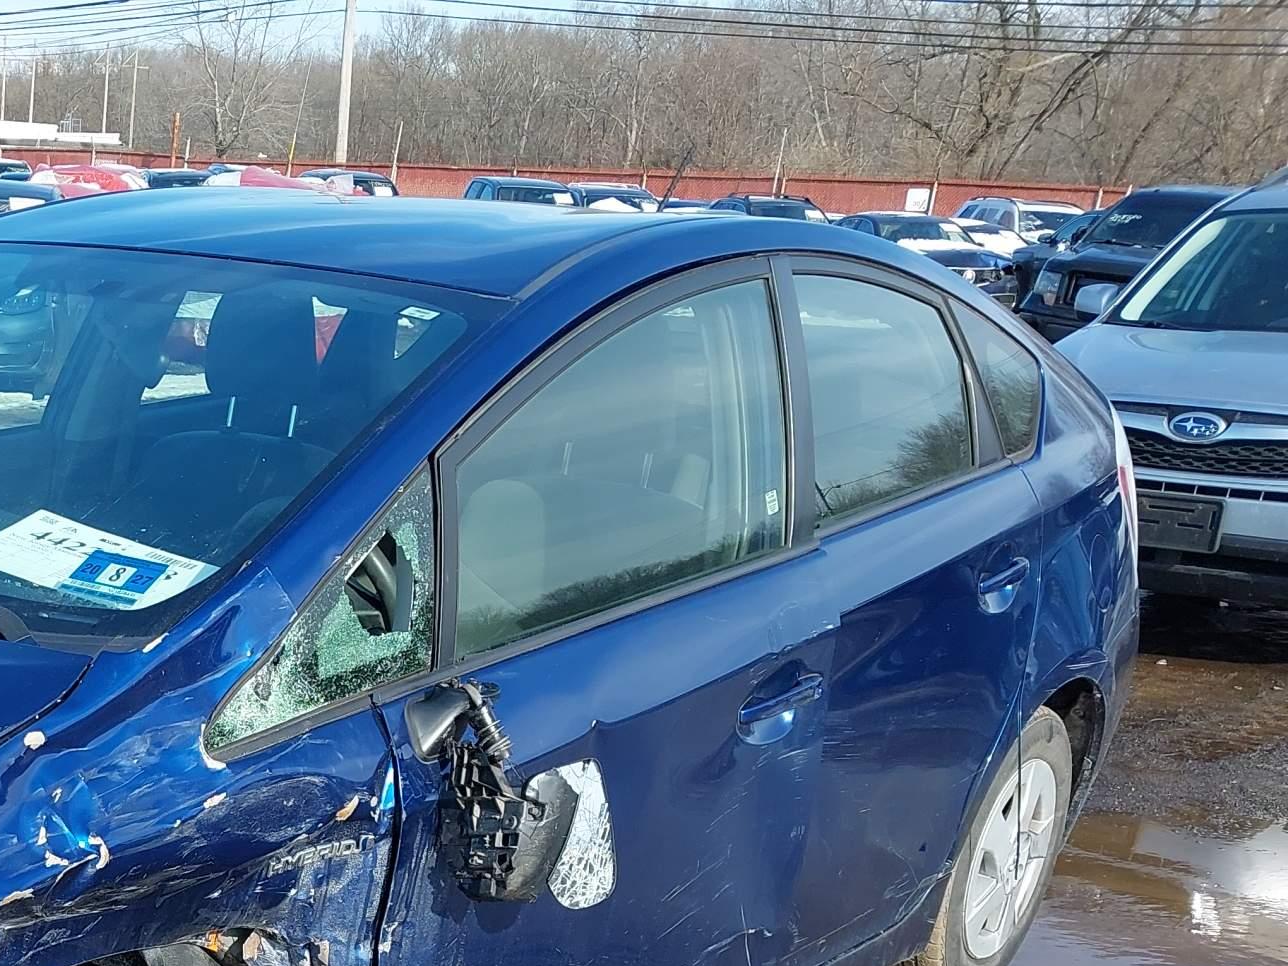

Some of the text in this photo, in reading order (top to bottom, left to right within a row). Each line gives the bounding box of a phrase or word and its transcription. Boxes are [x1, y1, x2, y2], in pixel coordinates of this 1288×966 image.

[79, 562, 102, 575] 20
[108, 567, 127, 582] 8
[130, 573, 154, 586] 27
[268, 839, 359, 878] HYBRID
